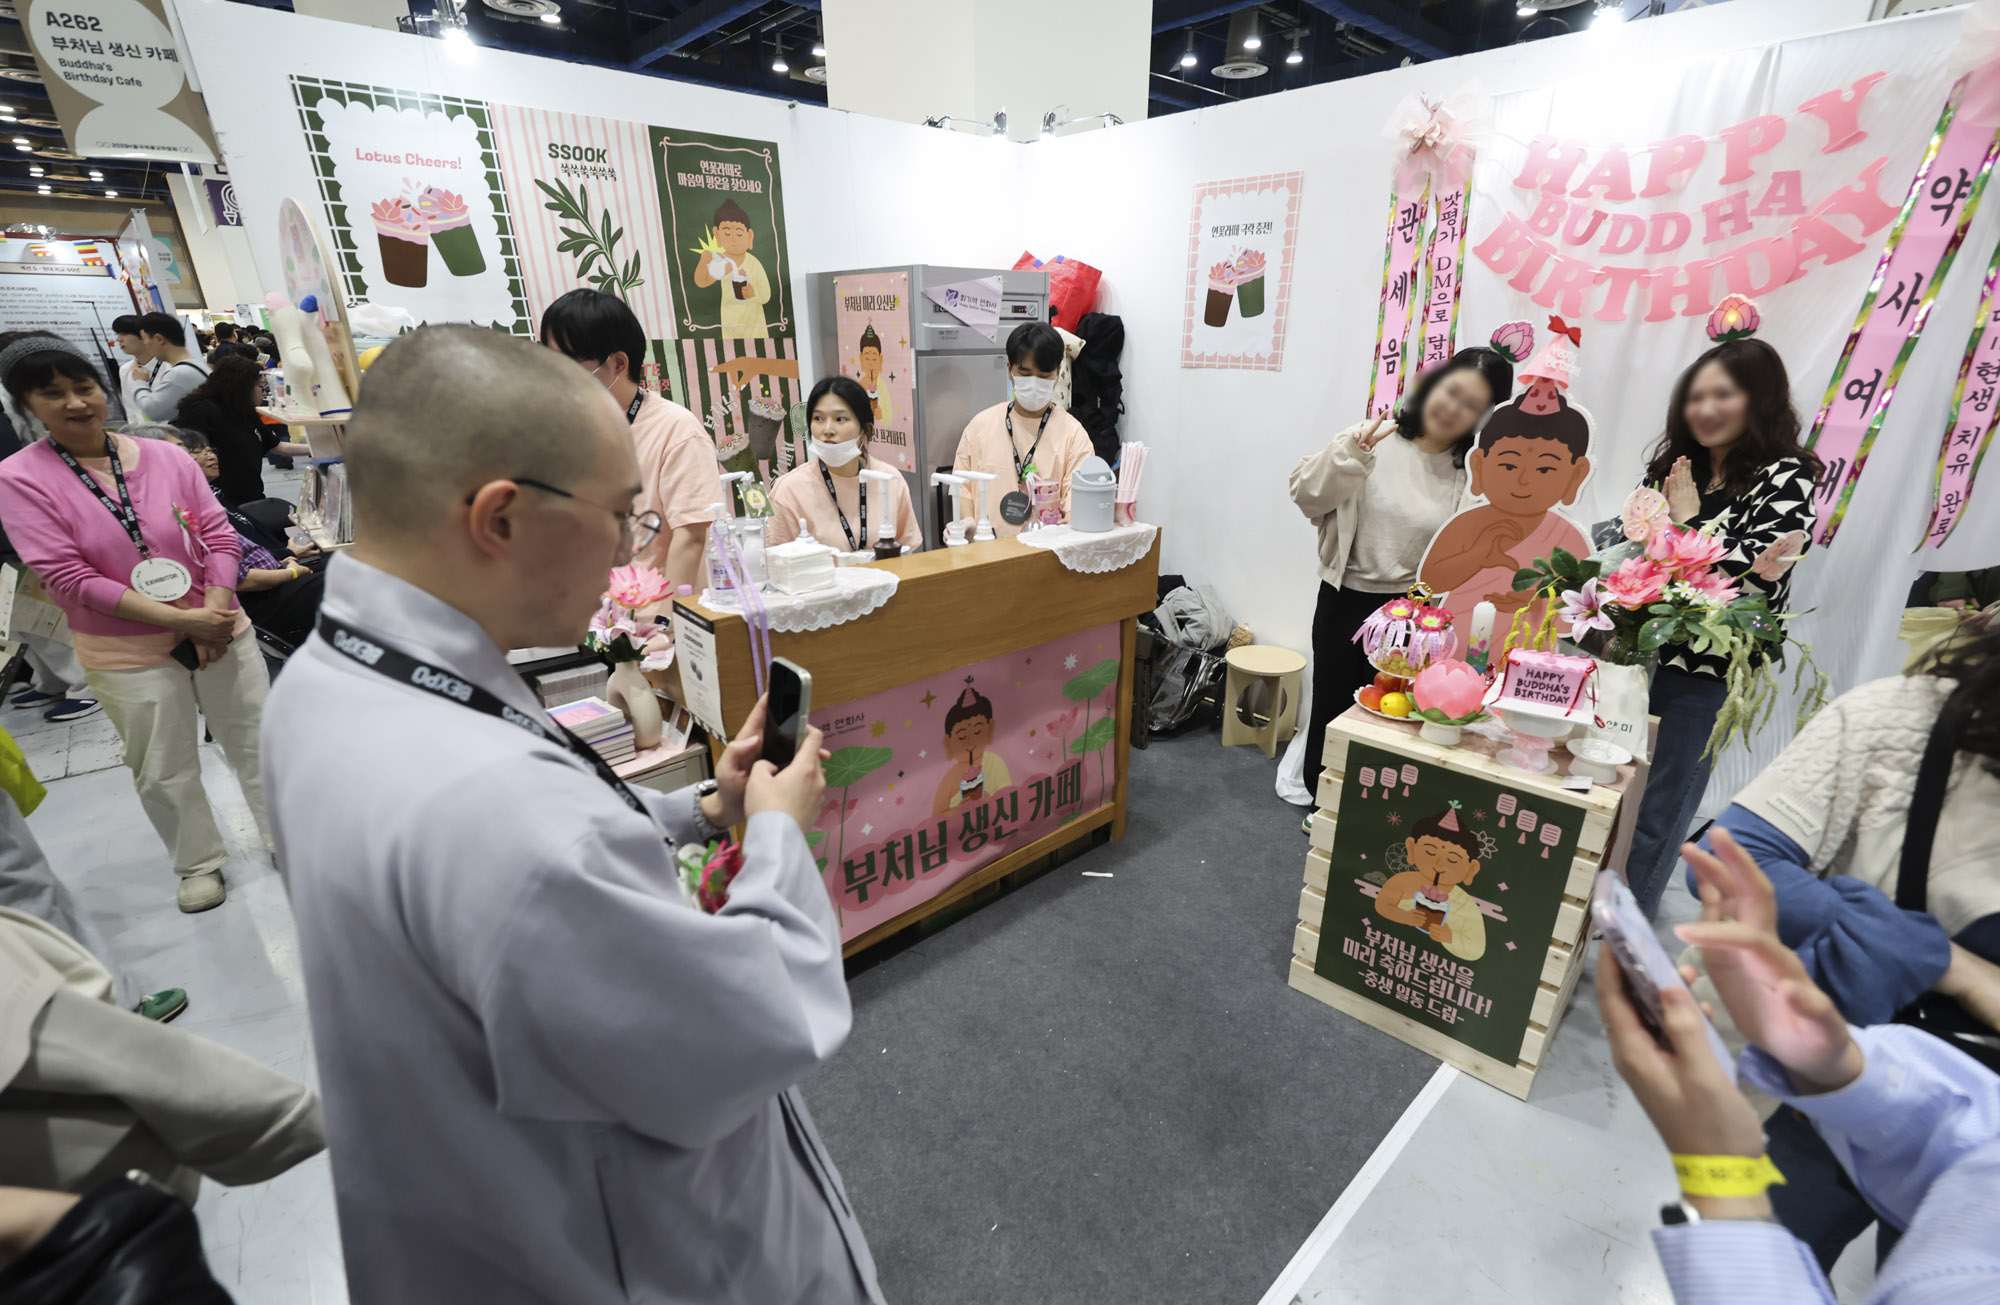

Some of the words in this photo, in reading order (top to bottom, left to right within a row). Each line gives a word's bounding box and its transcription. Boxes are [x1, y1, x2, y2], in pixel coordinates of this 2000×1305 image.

[46, 11, 103, 32] A262
[51, 36, 104, 55] 부처님
[108, 41, 143, 59] 생신
[145, 46, 179, 63] 카페
[59, 57, 113, 72] Buddha's
[63, 71, 114, 87] Birthday
[116, 76, 143, 87] Cafe
[1513, 71, 1887, 201] HAPPY
[355, 147, 401, 164] Lotus
[405, 153, 462, 170] Cheers!
[548, 143, 607, 164] SSOOK
[700, 160, 743, 178] 연꽃라떼로
[677, 172, 705, 188] 마음의
[705, 175, 730, 191] 평온을
[731, 178, 763, 194] 찾으세요
[1211, 224, 1240, 238] 연꽃라떼
[1241, 222, 1255, 236] 극락
[1472, 156, 1903, 323] BIRTHDAY
[1429, 256, 1453, 325] DM으로
[844, 295, 862, 312] 부처님
[862, 295, 876, 312] 미리
[876, 294, 896, 312] 오신날
[641, 363, 661, 377] TE
[703, 392, 738, 430] 부처님
[1946, 426, 1982, 476] 치유
[333, 629, 385, 665] BEXPO
[411, 666, 474, 701] BEXPO
[1516, 678, 1571, 694] BUDDHA'S
[1526, 668, 1565, 683] HAPPY
[1514, 687, 1571, 705] BIRTHDAY
[844, 820, 948, 904] 부처님
[958, 789, 1019, 853] 생신
[1028, 761, 1081, 822] 카페
[1364, 926, 1417, 964] 부처님
[1418, 949, 1475, 989] 생신을
[1342, 936, 1377, 968] 미리
[1379, 953, 1493, 1018] 축하드립니다!
[1395, 983, 1425, 1009] 일동
